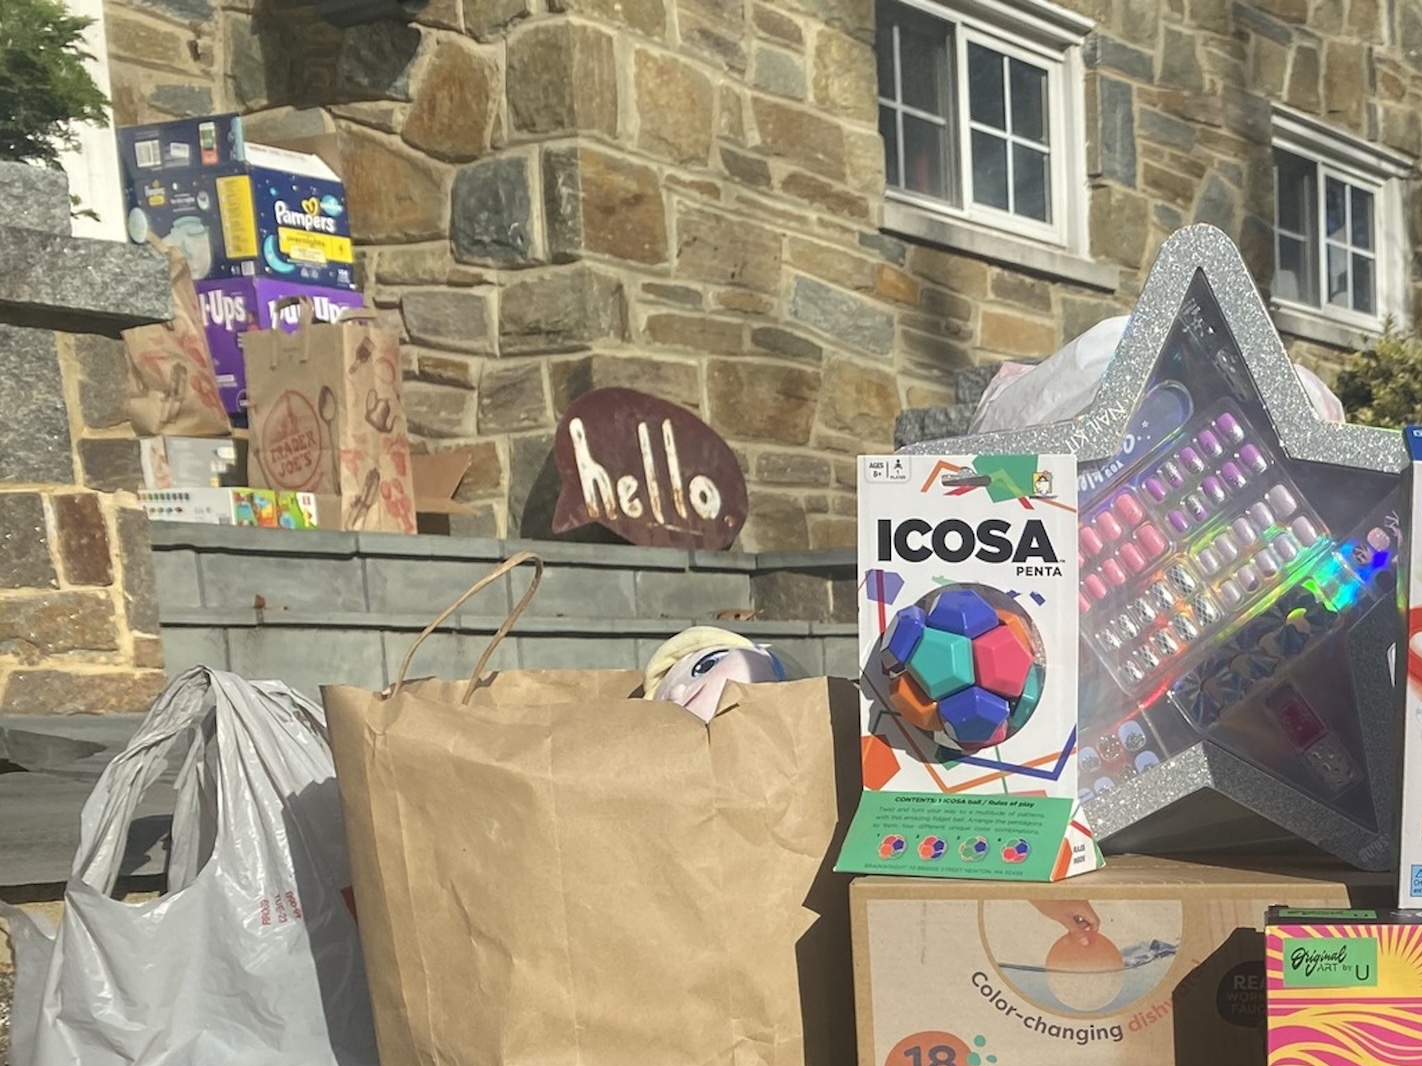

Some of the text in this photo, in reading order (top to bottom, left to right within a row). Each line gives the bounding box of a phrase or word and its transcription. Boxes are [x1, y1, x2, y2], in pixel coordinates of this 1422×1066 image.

[274, 200, 337, 234] Pampers
[1065, 401, 1126, 454] NAIL KIT
[270, 430, 317, 463] TRADER
[278, 453, 312, 477] JOE'S
[569, 418, 721, 524] hello
[877, 518, 1059, 563] ICOSA
[1016, 566, 1063, 577] PENTA
[1291, 945, 1347, 977] Original
[1317, 963, 1339, 973] ART
[972, 970, 1124, 1045] Color-changing
